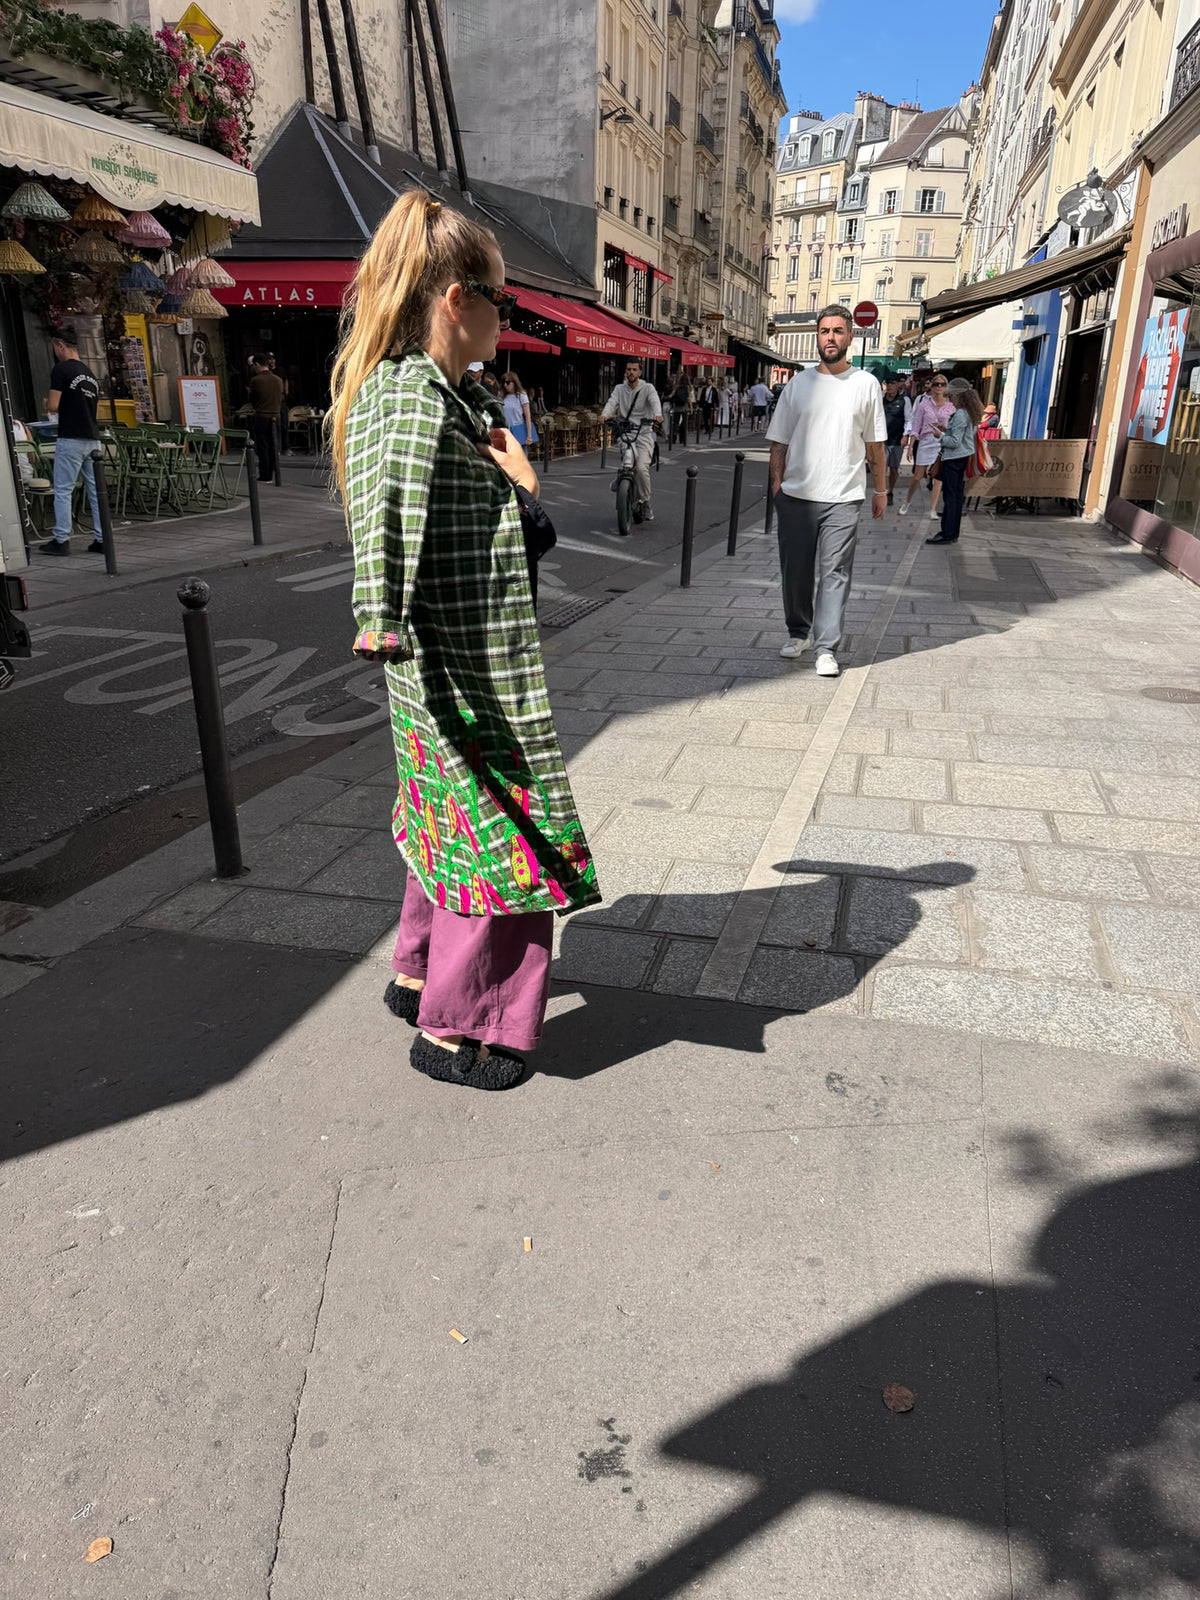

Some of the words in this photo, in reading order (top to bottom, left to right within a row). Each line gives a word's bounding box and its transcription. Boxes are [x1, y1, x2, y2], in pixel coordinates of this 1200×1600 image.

[91, 156, 121, 176] MAISON
[243, 287, 314, 301] ATLAS
[1147, 325, 1178, 356] TASCHEN
[1145, 357, 1172, 387] VENTE
[1006, 457, 1075, 473] Amorino
